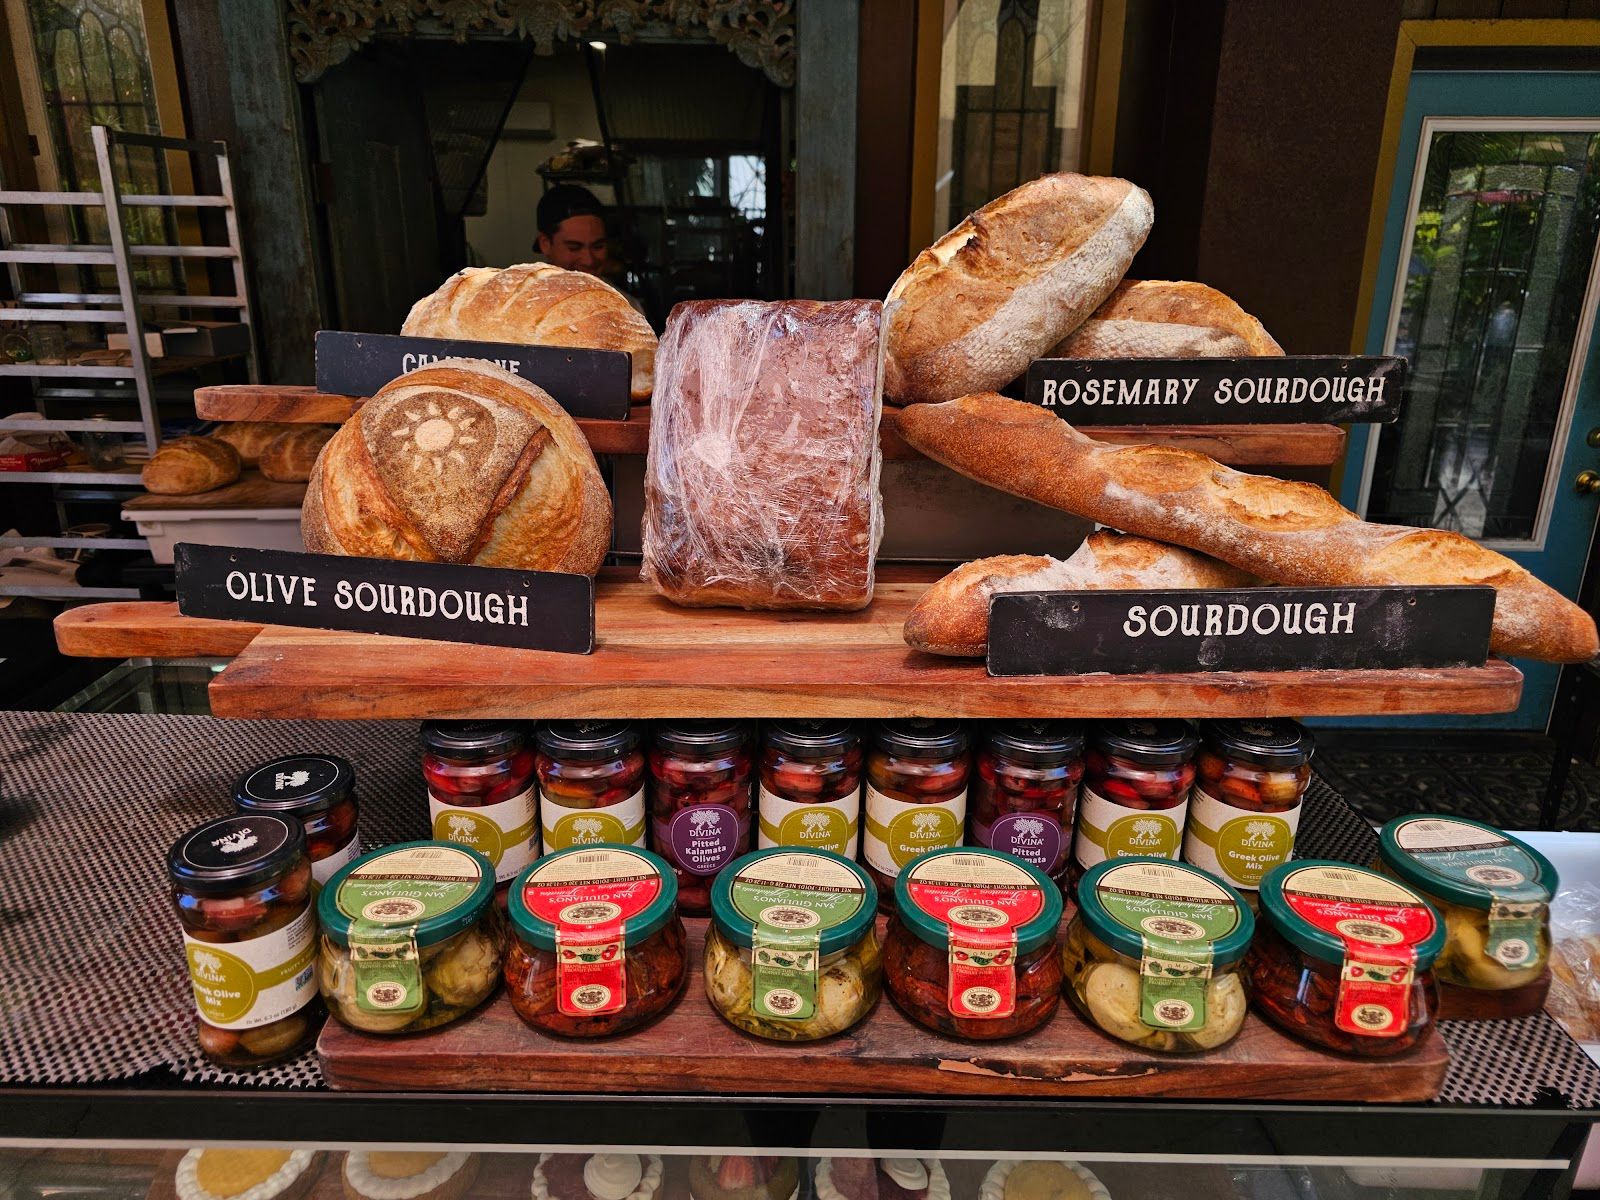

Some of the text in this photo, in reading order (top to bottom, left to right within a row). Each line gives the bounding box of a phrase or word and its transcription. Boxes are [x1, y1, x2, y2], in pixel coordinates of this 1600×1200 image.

[1041, 376, 1387, 405] ROSEMARY SOURDOUGH
[226, 570, 529, 626] OLIVE SOURDOUGH
[1122, 603, 1357, 637] SOURDOUGH
[211, 828, 252, 846] DIVINA
[689, 828, 721, 837] DIVINA
[909, 831, 940, 839] DIVINA
[449, 834, 478, 843] DIVINA
[692, 838, 720, 847] Pitted
[1011, 836, 1044, 845] DIVINA
[1241, 839, 1275, 848] DIVINA
[685, 845, 726, 855] Kalamata
[899, 844, 925, 853] Greek
[1012, 848, 1041, 856] Pitted
[1228, 850, 1279, 862] Greek Olive
[539, 881, 645, 898] Tomatoes Tomates
[548, 894, 609, 903] GIULIANO'S
[924, 888, 1026, 901] Tomatoes Tomates
[752, 896, 812, 907] GIULIANO'S
[934, 896, 994, 905] GIULIANO'S
[1125, 905, 1188, 918] GIULIANO'S
[1384, 916, 1407, 924] SAN
[214, 990, 241, 998] Olive
[206, 995, 222, 1006] Mix
